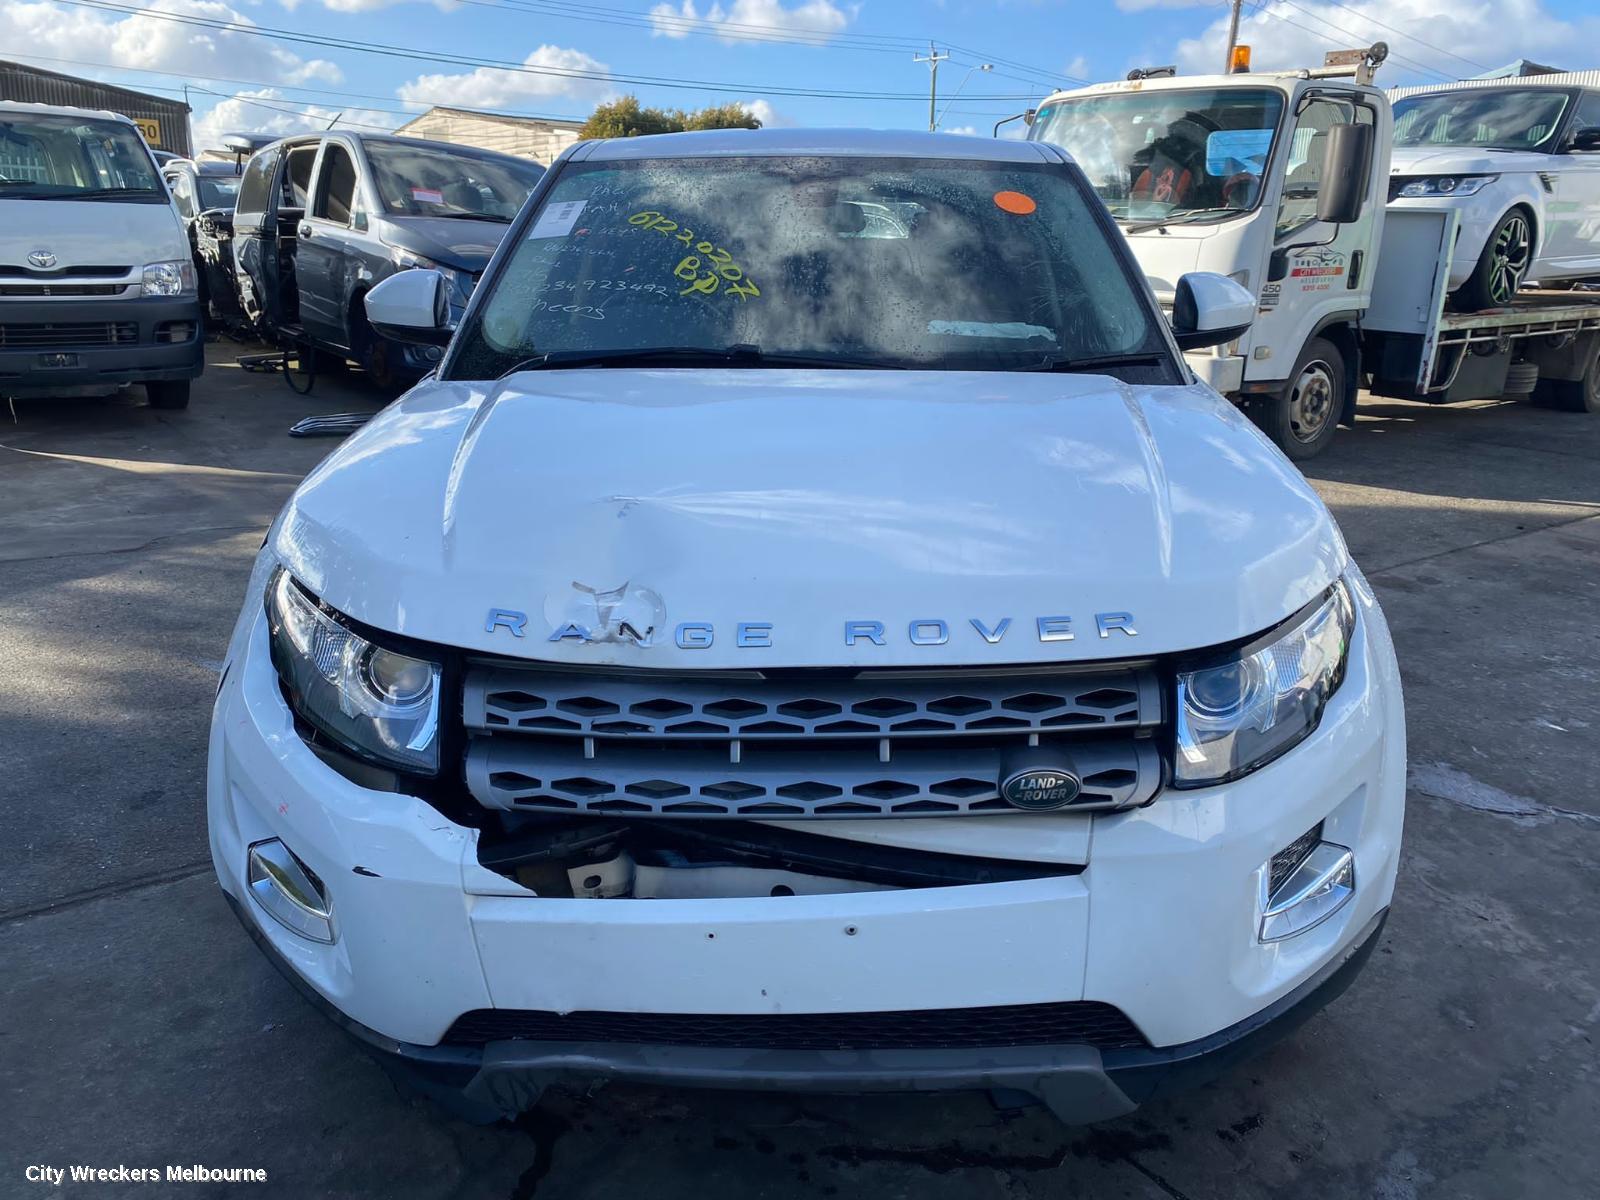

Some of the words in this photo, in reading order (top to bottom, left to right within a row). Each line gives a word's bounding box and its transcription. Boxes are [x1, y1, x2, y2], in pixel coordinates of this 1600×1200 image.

[1262, 284, 1281, 292] 450
[485, 607, 774, 650] RANGE
[844, 611, 1138, 646] ROVER
